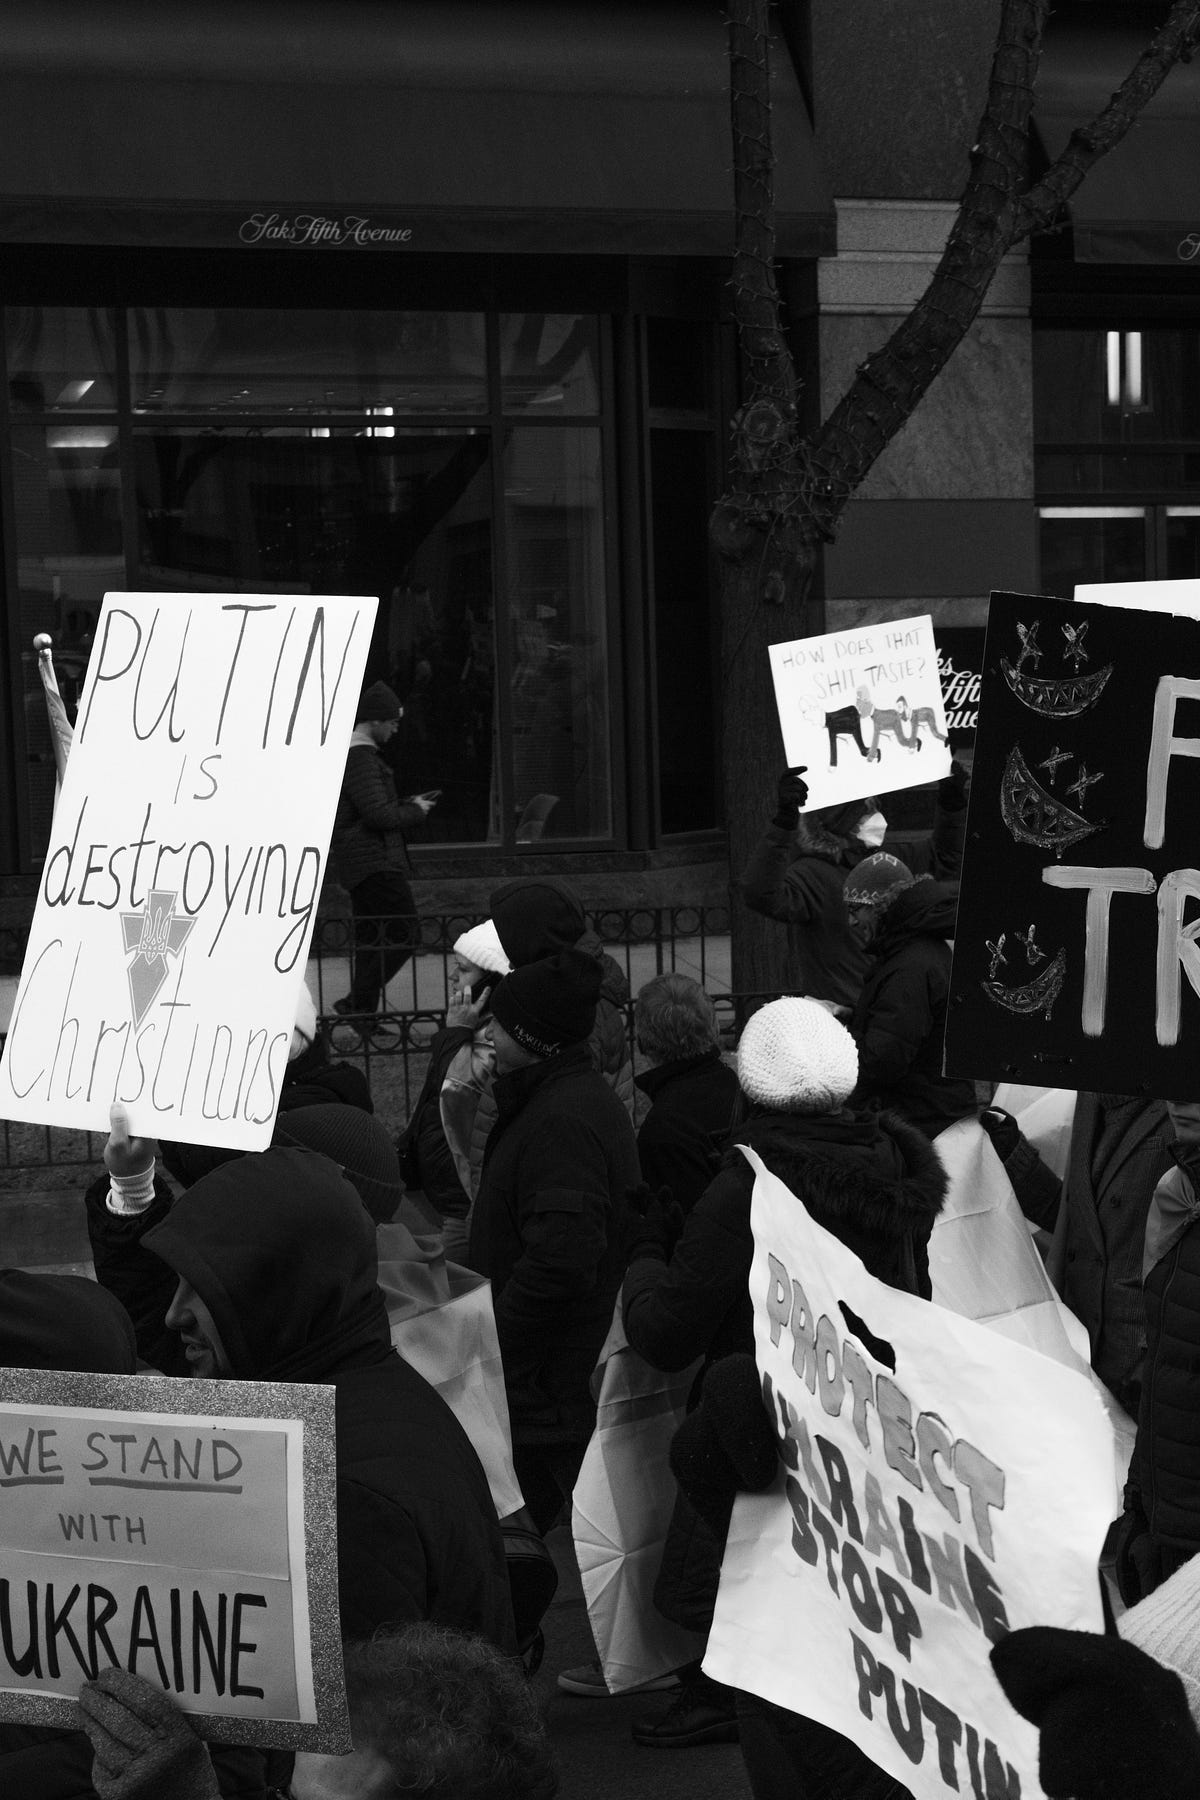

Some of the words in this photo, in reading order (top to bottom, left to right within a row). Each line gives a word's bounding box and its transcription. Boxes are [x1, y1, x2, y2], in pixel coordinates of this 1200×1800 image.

[239, 213, 296, 243] Saks
[289, 215, 342, 245] Fifth
[330, 216, 413, 246] Avenue
[79, 604, 361, 750] PUTIN
[781, 646, 826, 668] HOW
[834, 637, 875, 659] DOES
[885, 626, 926, 649] THAT
[812, 667, 858, 700] SHIT
[864, 657, 927, 688] TASTE?
[0, 1427, 64, 1477] WE
[81, 1432, 243, 1482] STAND
[766, 1252, 1006, 1563] PROTECT
[58, 1512, 147, 1546] WITH
[761, 1370, 1011, 1646] UKRAINE
[786, 1473, 923, 1664] STOP
[0, 1577, 269, 1700] UKRAINE
[848, 1626, 1022, 1800] PUTIN
